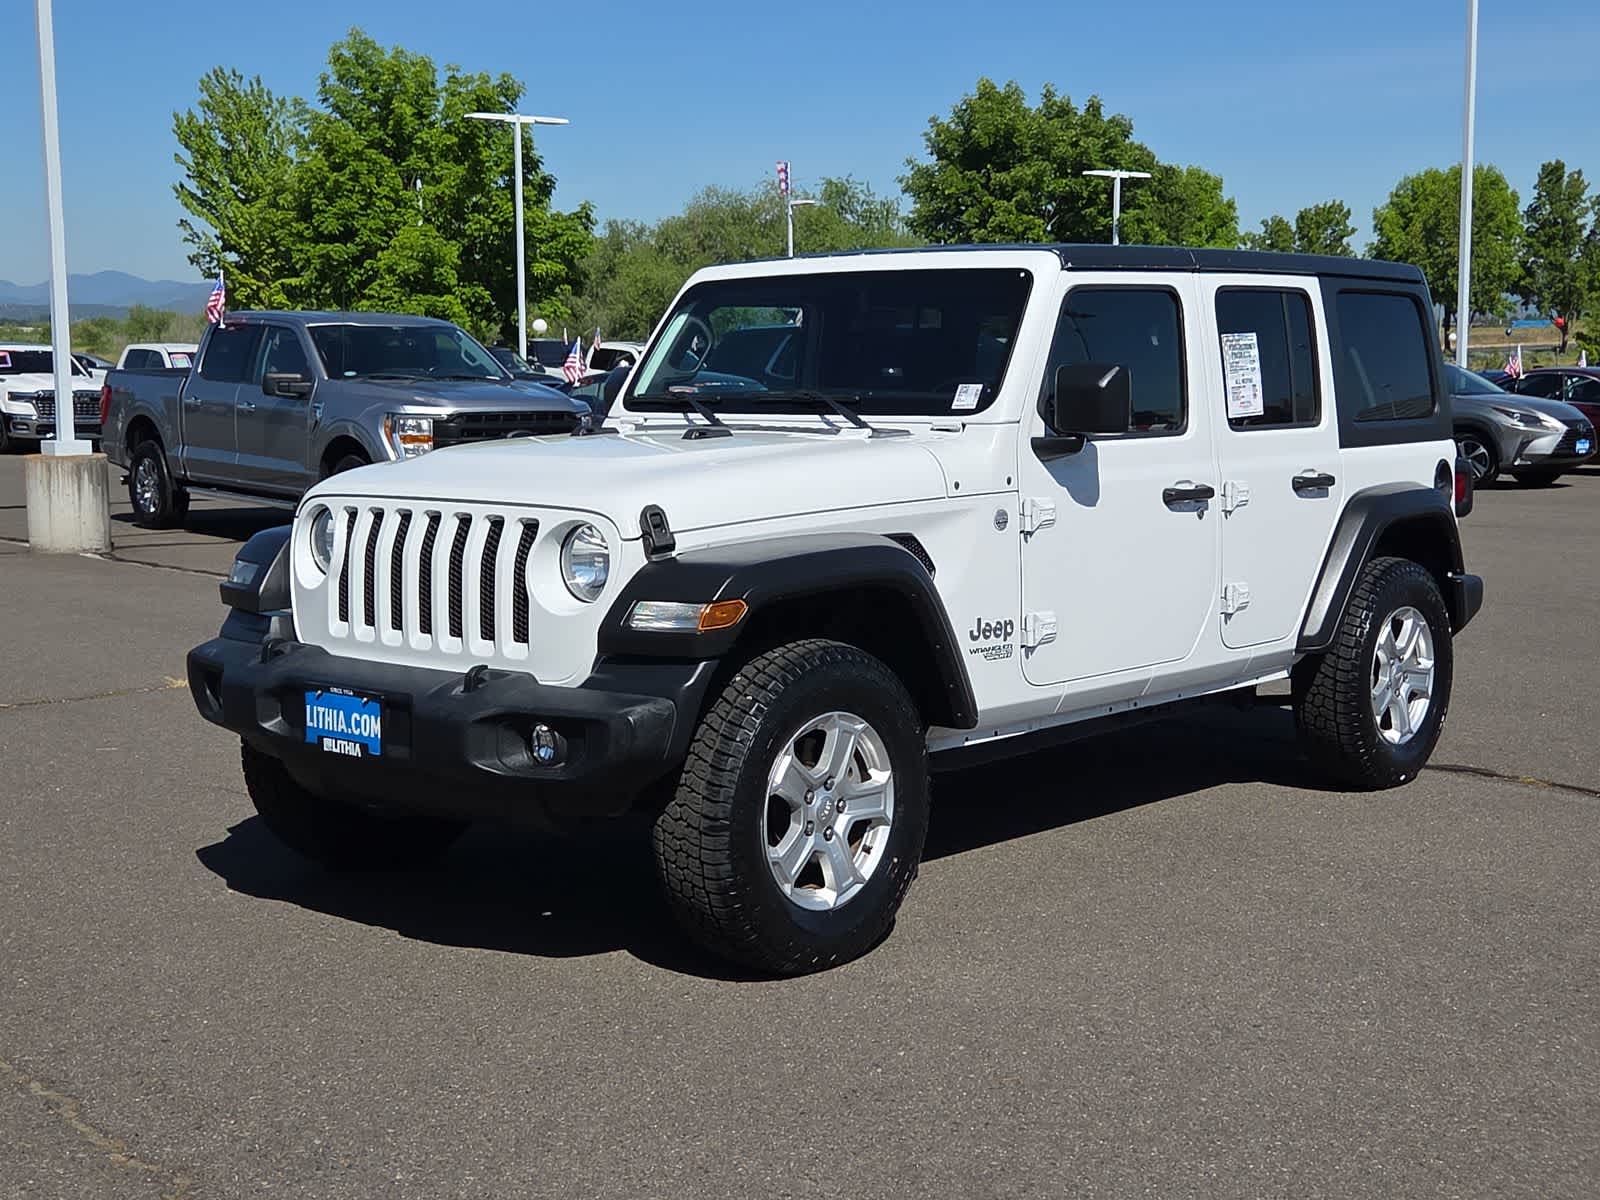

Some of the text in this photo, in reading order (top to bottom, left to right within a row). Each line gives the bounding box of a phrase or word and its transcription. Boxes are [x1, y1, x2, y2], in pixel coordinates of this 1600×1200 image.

[969, 617, 1014, 642] Jeep
[305, 704, 382, 740] LITHIA.COM
[332, 738, 362, 758] LITHIA
